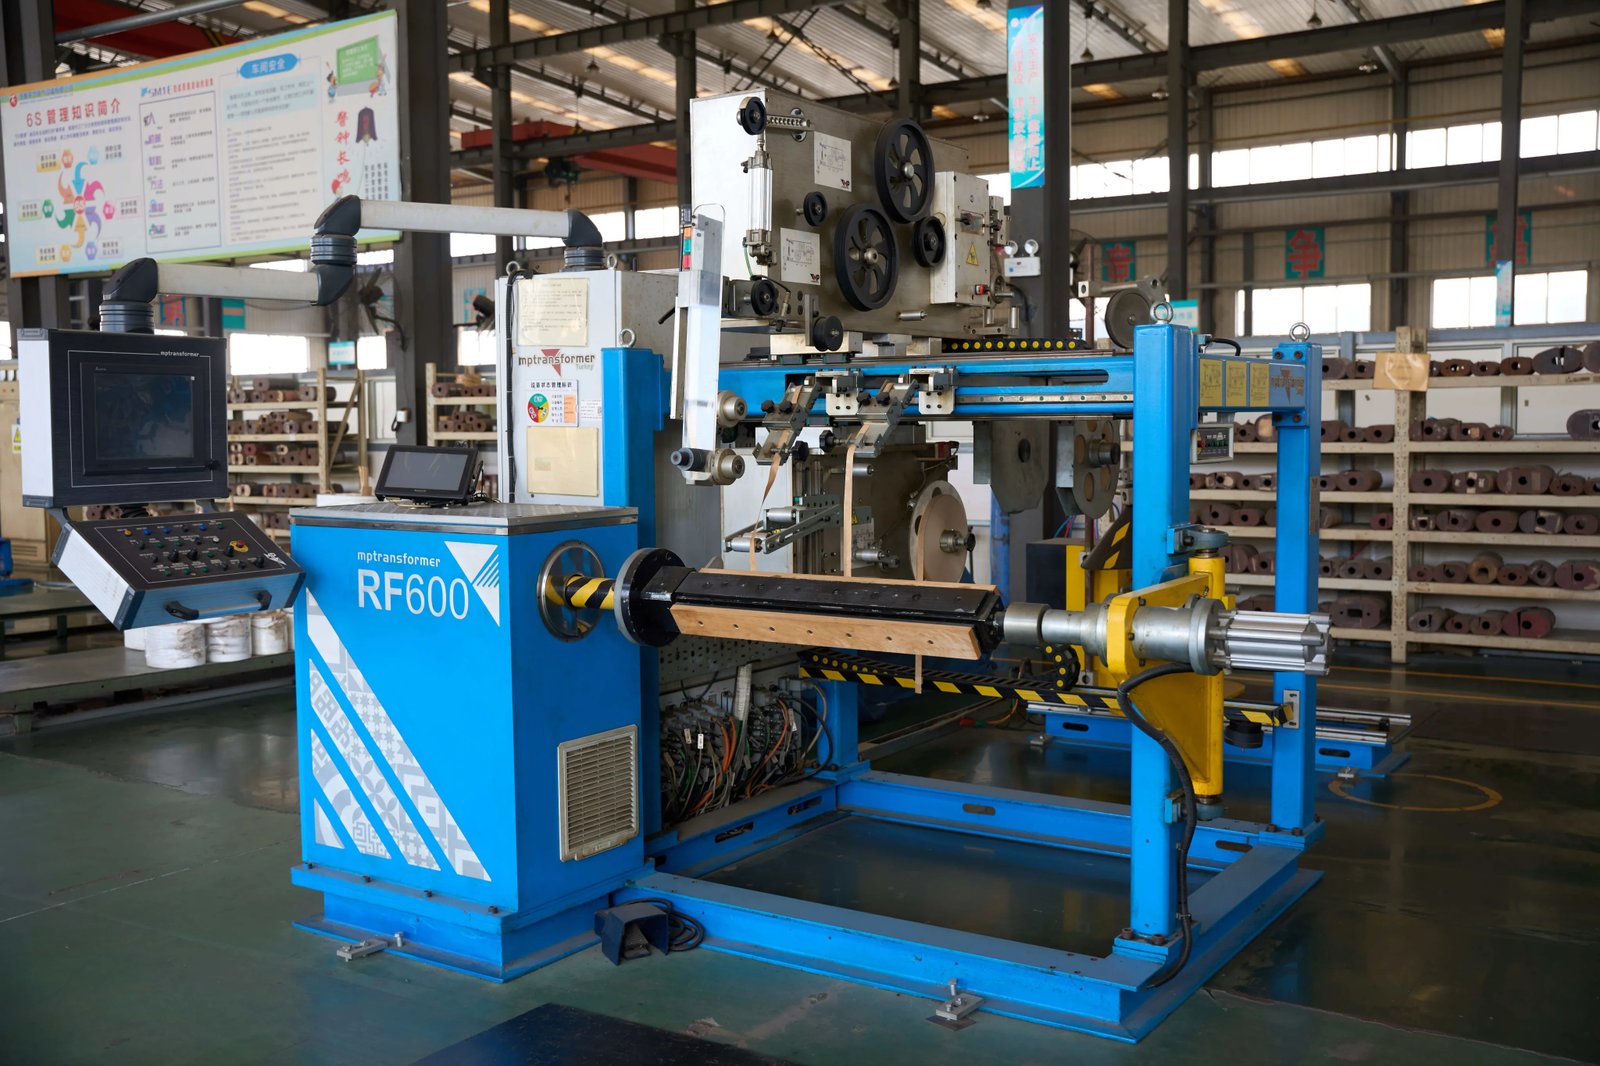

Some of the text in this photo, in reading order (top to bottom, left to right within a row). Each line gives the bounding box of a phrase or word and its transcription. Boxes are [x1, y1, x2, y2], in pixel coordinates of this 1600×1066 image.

[251, 58, 285, 74] 车间安全
[26, 98, 121, 128] 6S 管理知识简介
[335, 110, 352, 184] 警钟长鸣
[518, 353, 595, 367] mptransformer
[357, 550, 440, 567] mptransformer
[357, 569, 469, 620] RF600
